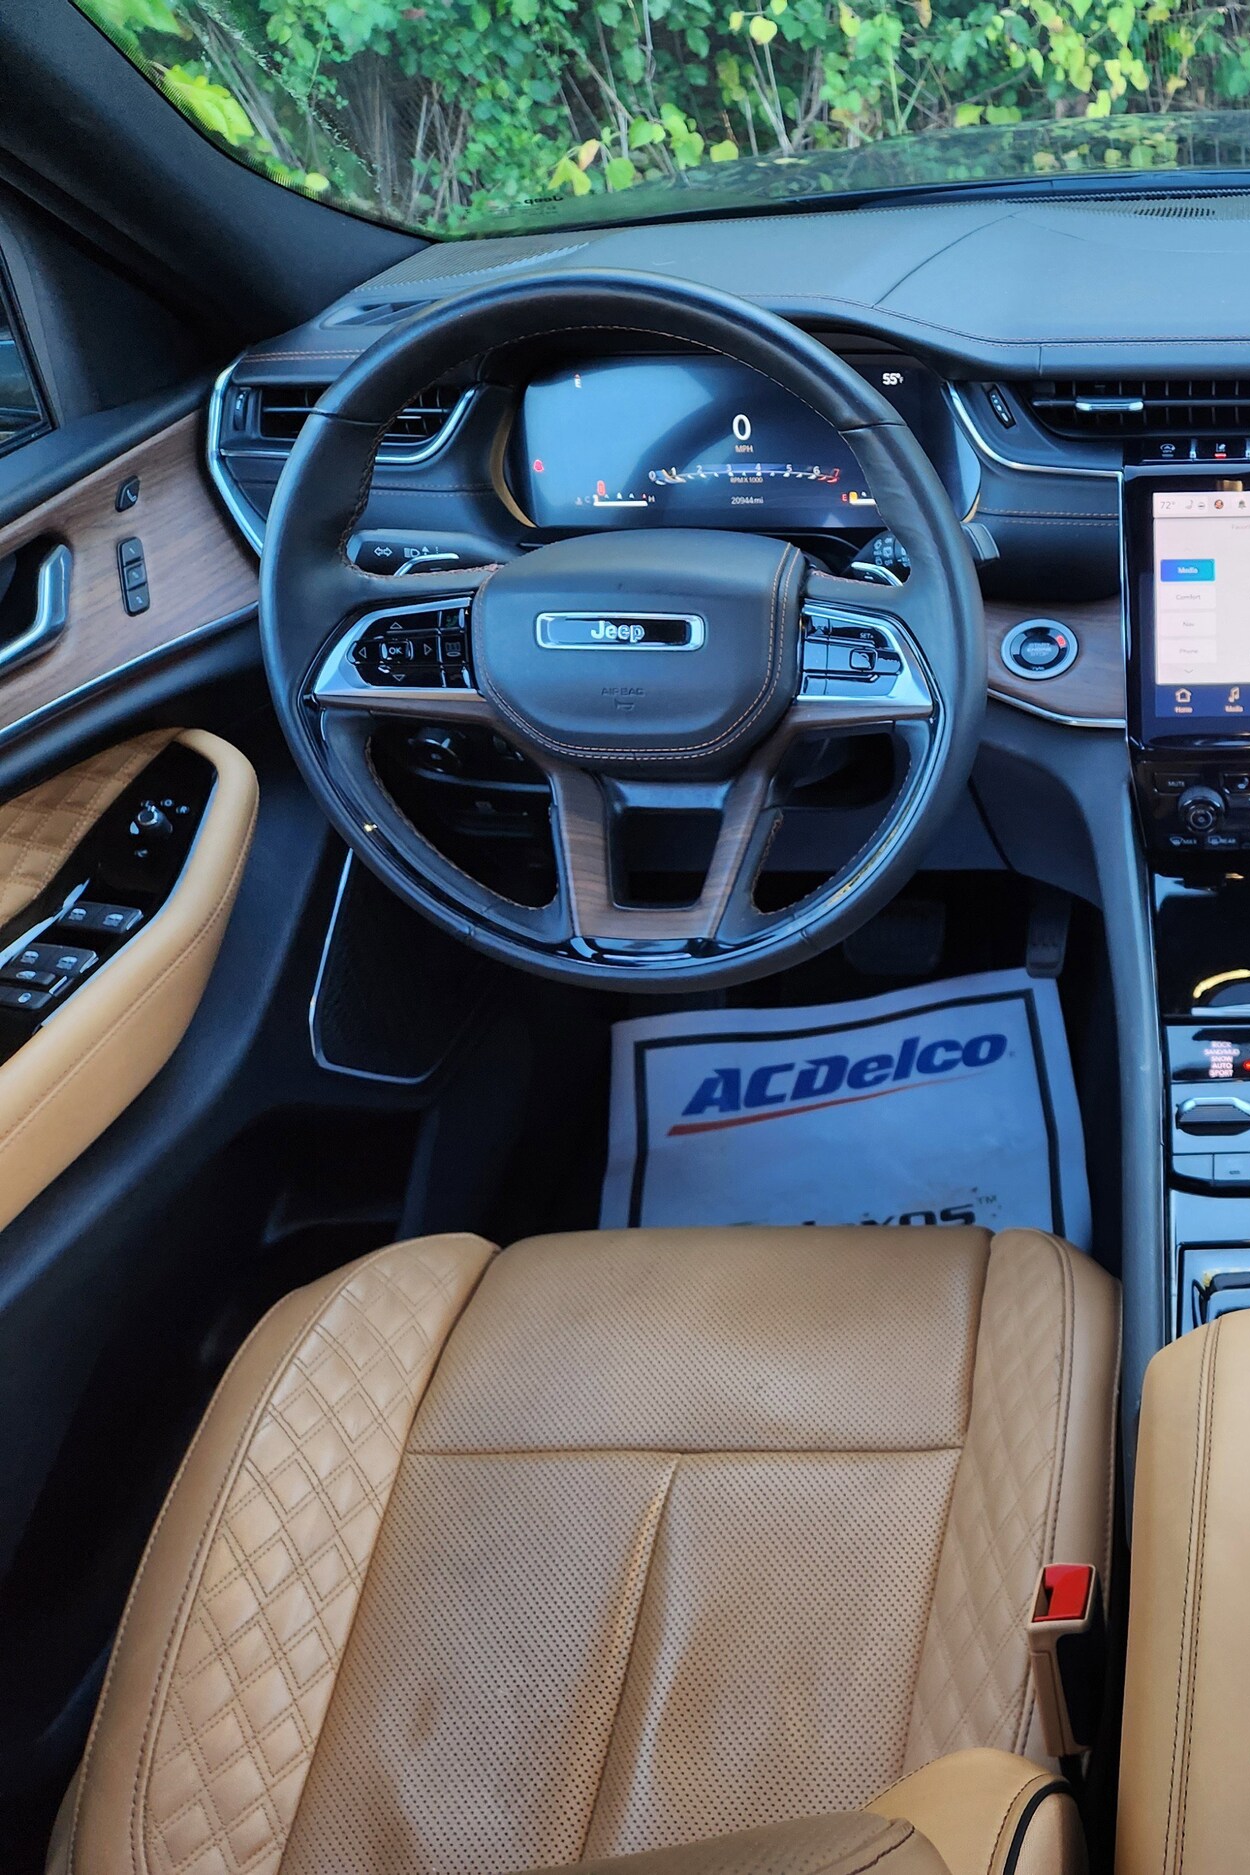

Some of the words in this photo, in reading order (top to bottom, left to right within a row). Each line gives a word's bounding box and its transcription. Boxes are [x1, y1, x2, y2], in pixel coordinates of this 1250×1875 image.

[732, 414, 751, 441] 0
[735, 445, 754, 453] MPH
[590, 620, 645, 643] Jeep
[388, 647, 403, 655] OK
[601, 687, 646, 697] AIRBAG
[681, 1033, 1008, 1117] ACDelco
[1208, 1069, 1233, 1077] SPORT
